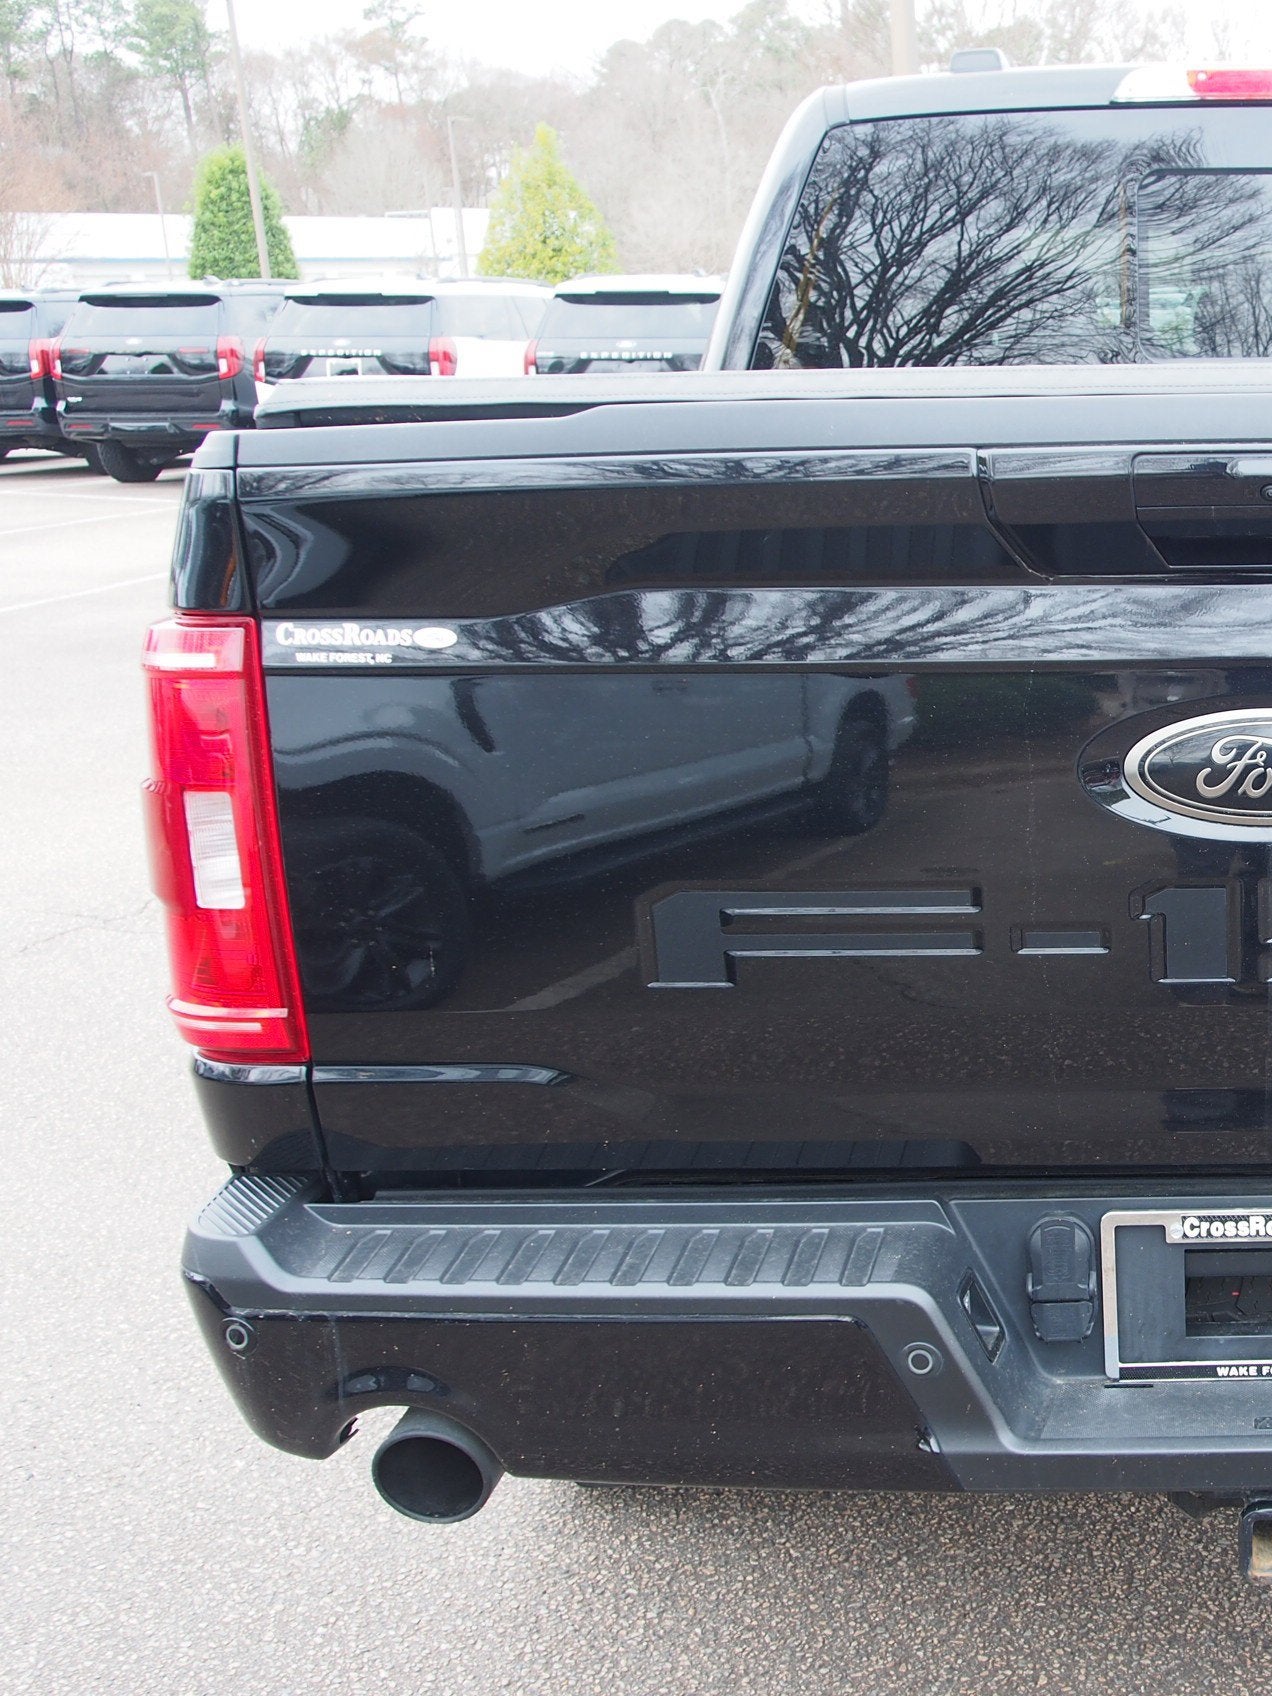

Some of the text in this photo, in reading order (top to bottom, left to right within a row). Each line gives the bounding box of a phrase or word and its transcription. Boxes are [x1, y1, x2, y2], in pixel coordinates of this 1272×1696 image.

[295, 652, 393, 665] WAKE FOREST, NC
[1216, 1365, 1257, 1377] WAKE
